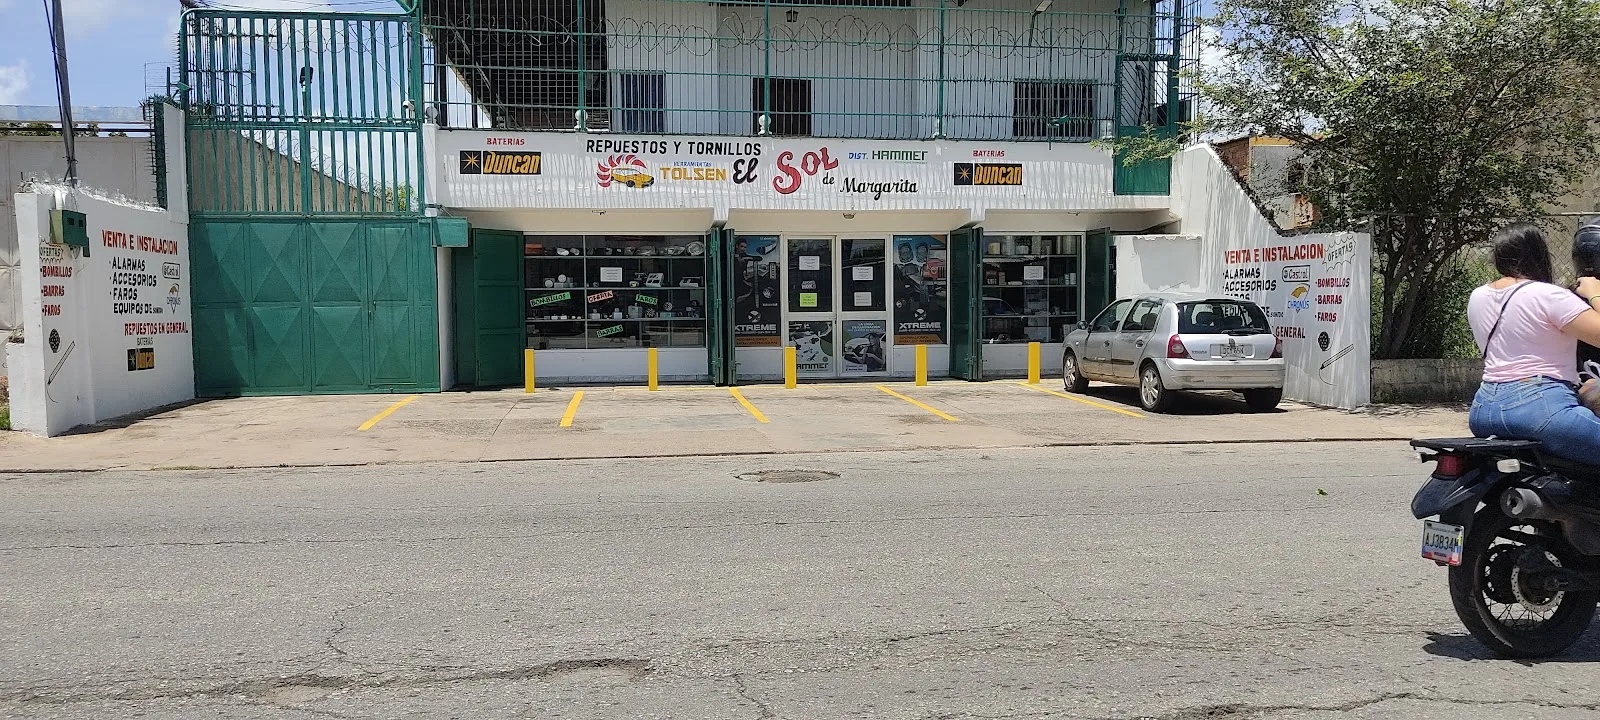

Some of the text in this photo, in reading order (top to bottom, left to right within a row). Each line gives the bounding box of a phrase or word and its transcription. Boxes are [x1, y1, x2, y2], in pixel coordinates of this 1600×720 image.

[486, 137, 525, 146] BATERIAS
[586, 139, 762, 156] REPUESTOS Y TORNILLOS
[848, 152, 868, 160] DIST.
[659, 167, 727, 181] TOLSEN
[732, 158, 759, 185] El
[822, 172, 835, 185] de
[839, 178, 918, 201] Margarita
[101, 229, 178, 256] VENTA E INSTALACION
[1224, 243, 1324, 264] VENTA E INSTALACION
[111, 256, 146, 272] ALARMAS
[42, 265, 73, 278] BOMBILLOS
[1224, 267, 1261, 279] ALARMAS
[112, 271, 158, 288] ACCESORIOS
[1224, 279, 1277, 292] ACCESORIOS
[1317, 277, 1351, 288] BOMBILLOS
[43, 285, 65, 297] BARRAS
[113, 287, 138, 301] FAROS
[1317, 294, 1343, 305] BARRAS
[43, 304, 61, 317] FAROS
[113, 302, 143, 316] EQUIPOS
[144, 303, 153, 314] DE
[1317, 311, 1337, 322] FAROS
[124, 323, 157, 337] REPUESTOS
[166, 321, 189, 335] GENERAL
[1275, 326, 1306, 339] GENERAL
